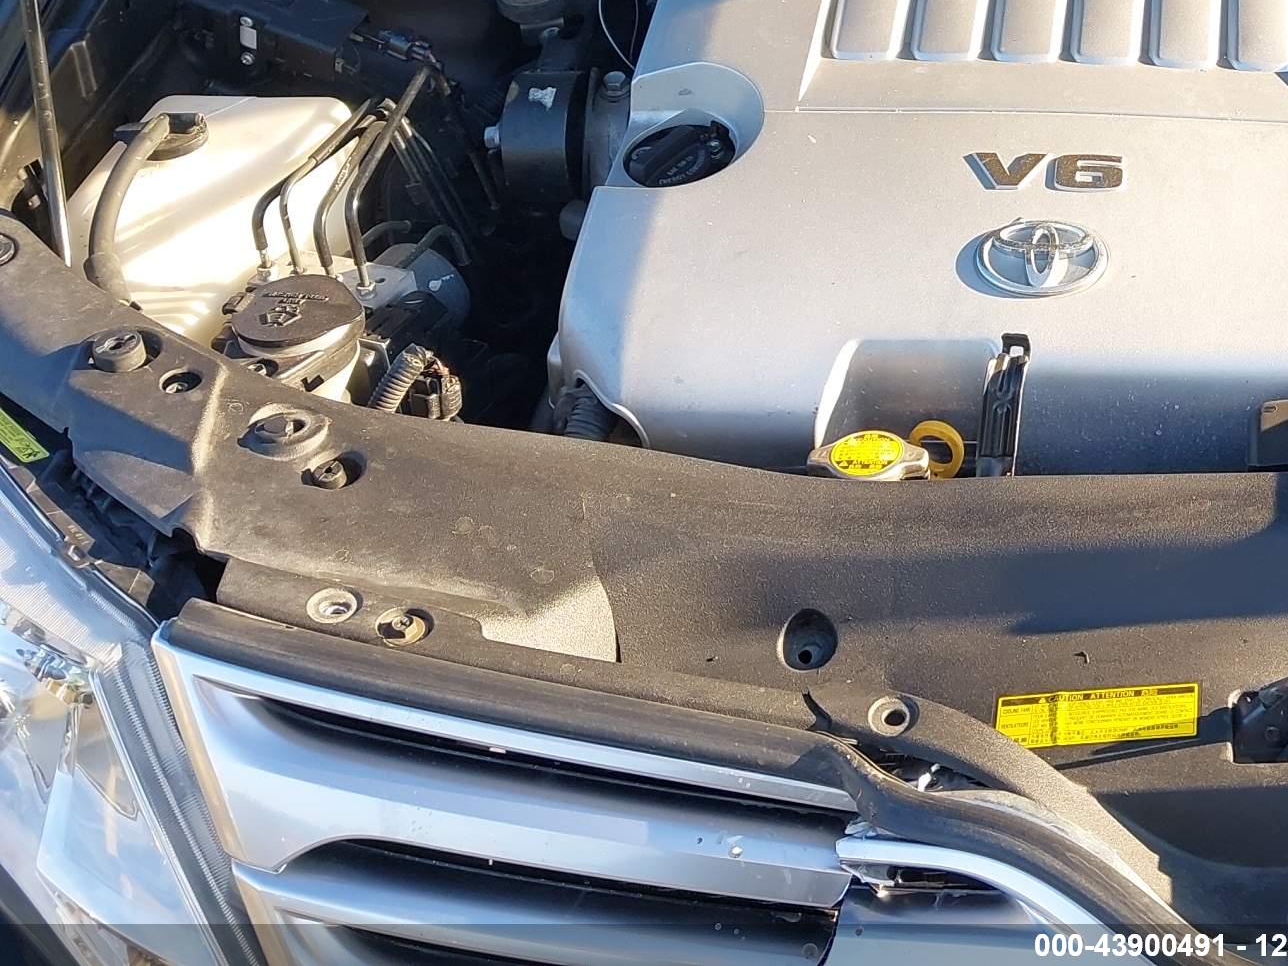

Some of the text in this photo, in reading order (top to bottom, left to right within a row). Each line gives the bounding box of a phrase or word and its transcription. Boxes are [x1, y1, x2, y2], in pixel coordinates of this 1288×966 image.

[970, 152, 1123, 190] V6
[1048, 694, 1084, 703] CAUTION
[1090, 690, 1135, 700] ATTENTION
